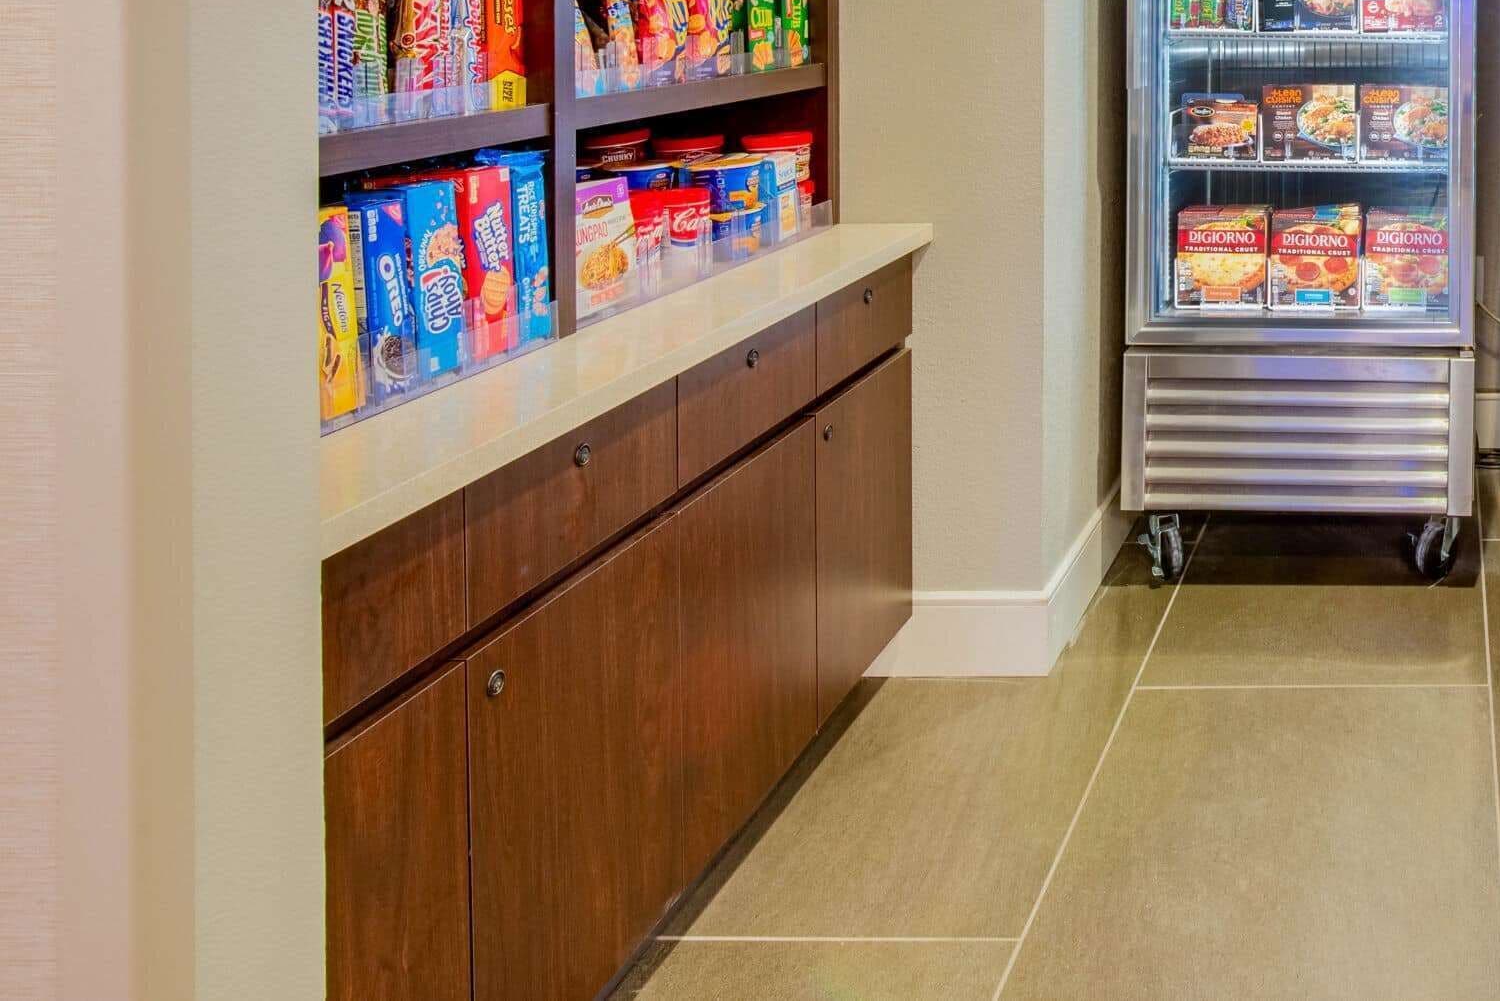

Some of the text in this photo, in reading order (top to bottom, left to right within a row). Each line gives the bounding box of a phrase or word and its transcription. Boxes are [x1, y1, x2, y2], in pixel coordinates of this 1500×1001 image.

[334, 11, 355, 109] SNICKERS
[601, 150, 635, 164] CHUNKY
[485, 202, 511, 261] Nutter
[515, 184, 530, 245] TREATS
[526, 181, 540, 244] RICE KRISPIES
[576, 220, 609, 247] UNGPAO
[1189, 231, 1256, 244] DIGIORNO
[1376, 231, 1443, 245] DIGIORNO
[418, 229, 432, 272] ORIGINAL
[474, 217, 503, 272] Butter
[1282, 233, 1349, 247] DIGIORNO
[322, 305, 330, 323] FIG
[331, 282, 349, 335] Newtons
[376, 254, 405, 328] OREO
[425, 281, 451, 334] Chips
